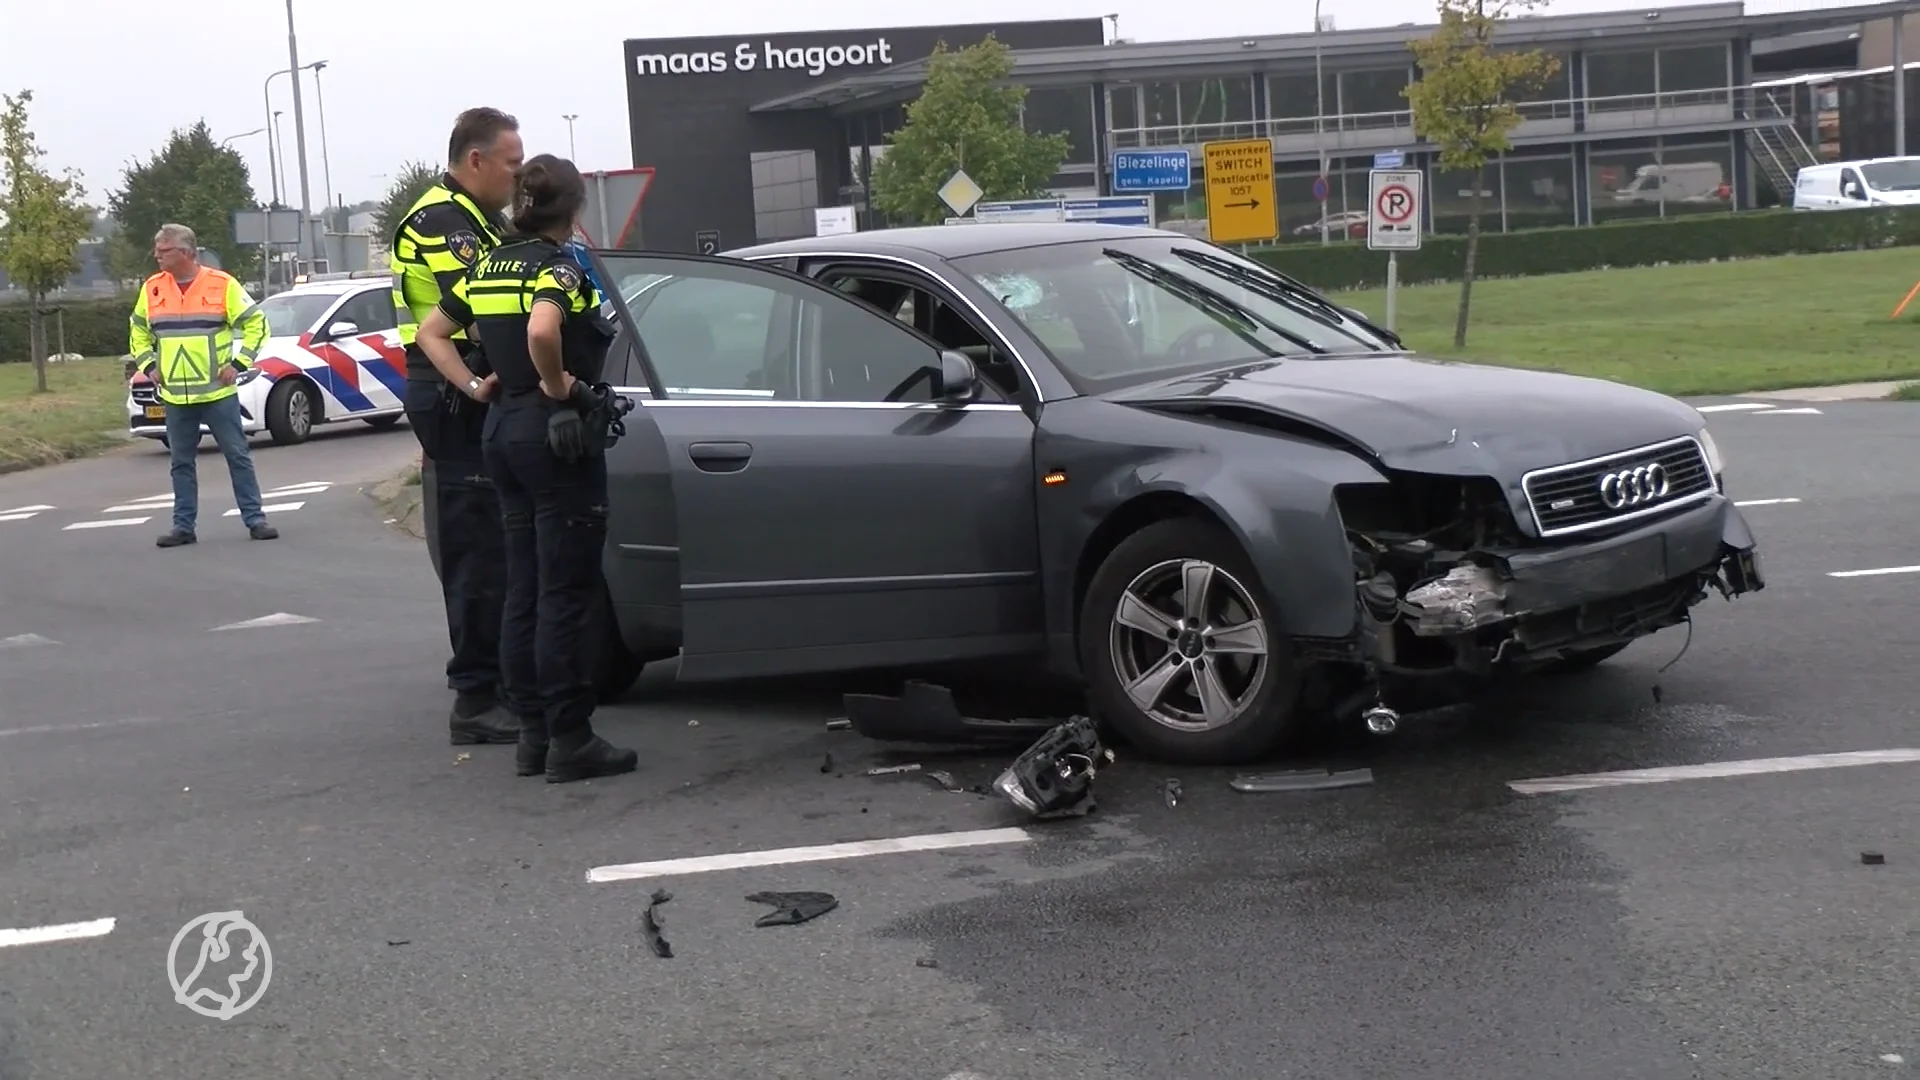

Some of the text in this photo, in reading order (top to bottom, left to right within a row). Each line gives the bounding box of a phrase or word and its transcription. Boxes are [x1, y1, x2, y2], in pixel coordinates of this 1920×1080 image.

[636, 38, 892, 76] maas & hagoort
[1208, 146, 1269, 157] werkverkeer
[1118, 156, 1185, 171] Biezelinge
[1215, 158, 1262, 170] SWITCH
[1211, 173, 1270, 184] mastlocatie
[1230, 186, 1252, 196] 1057
